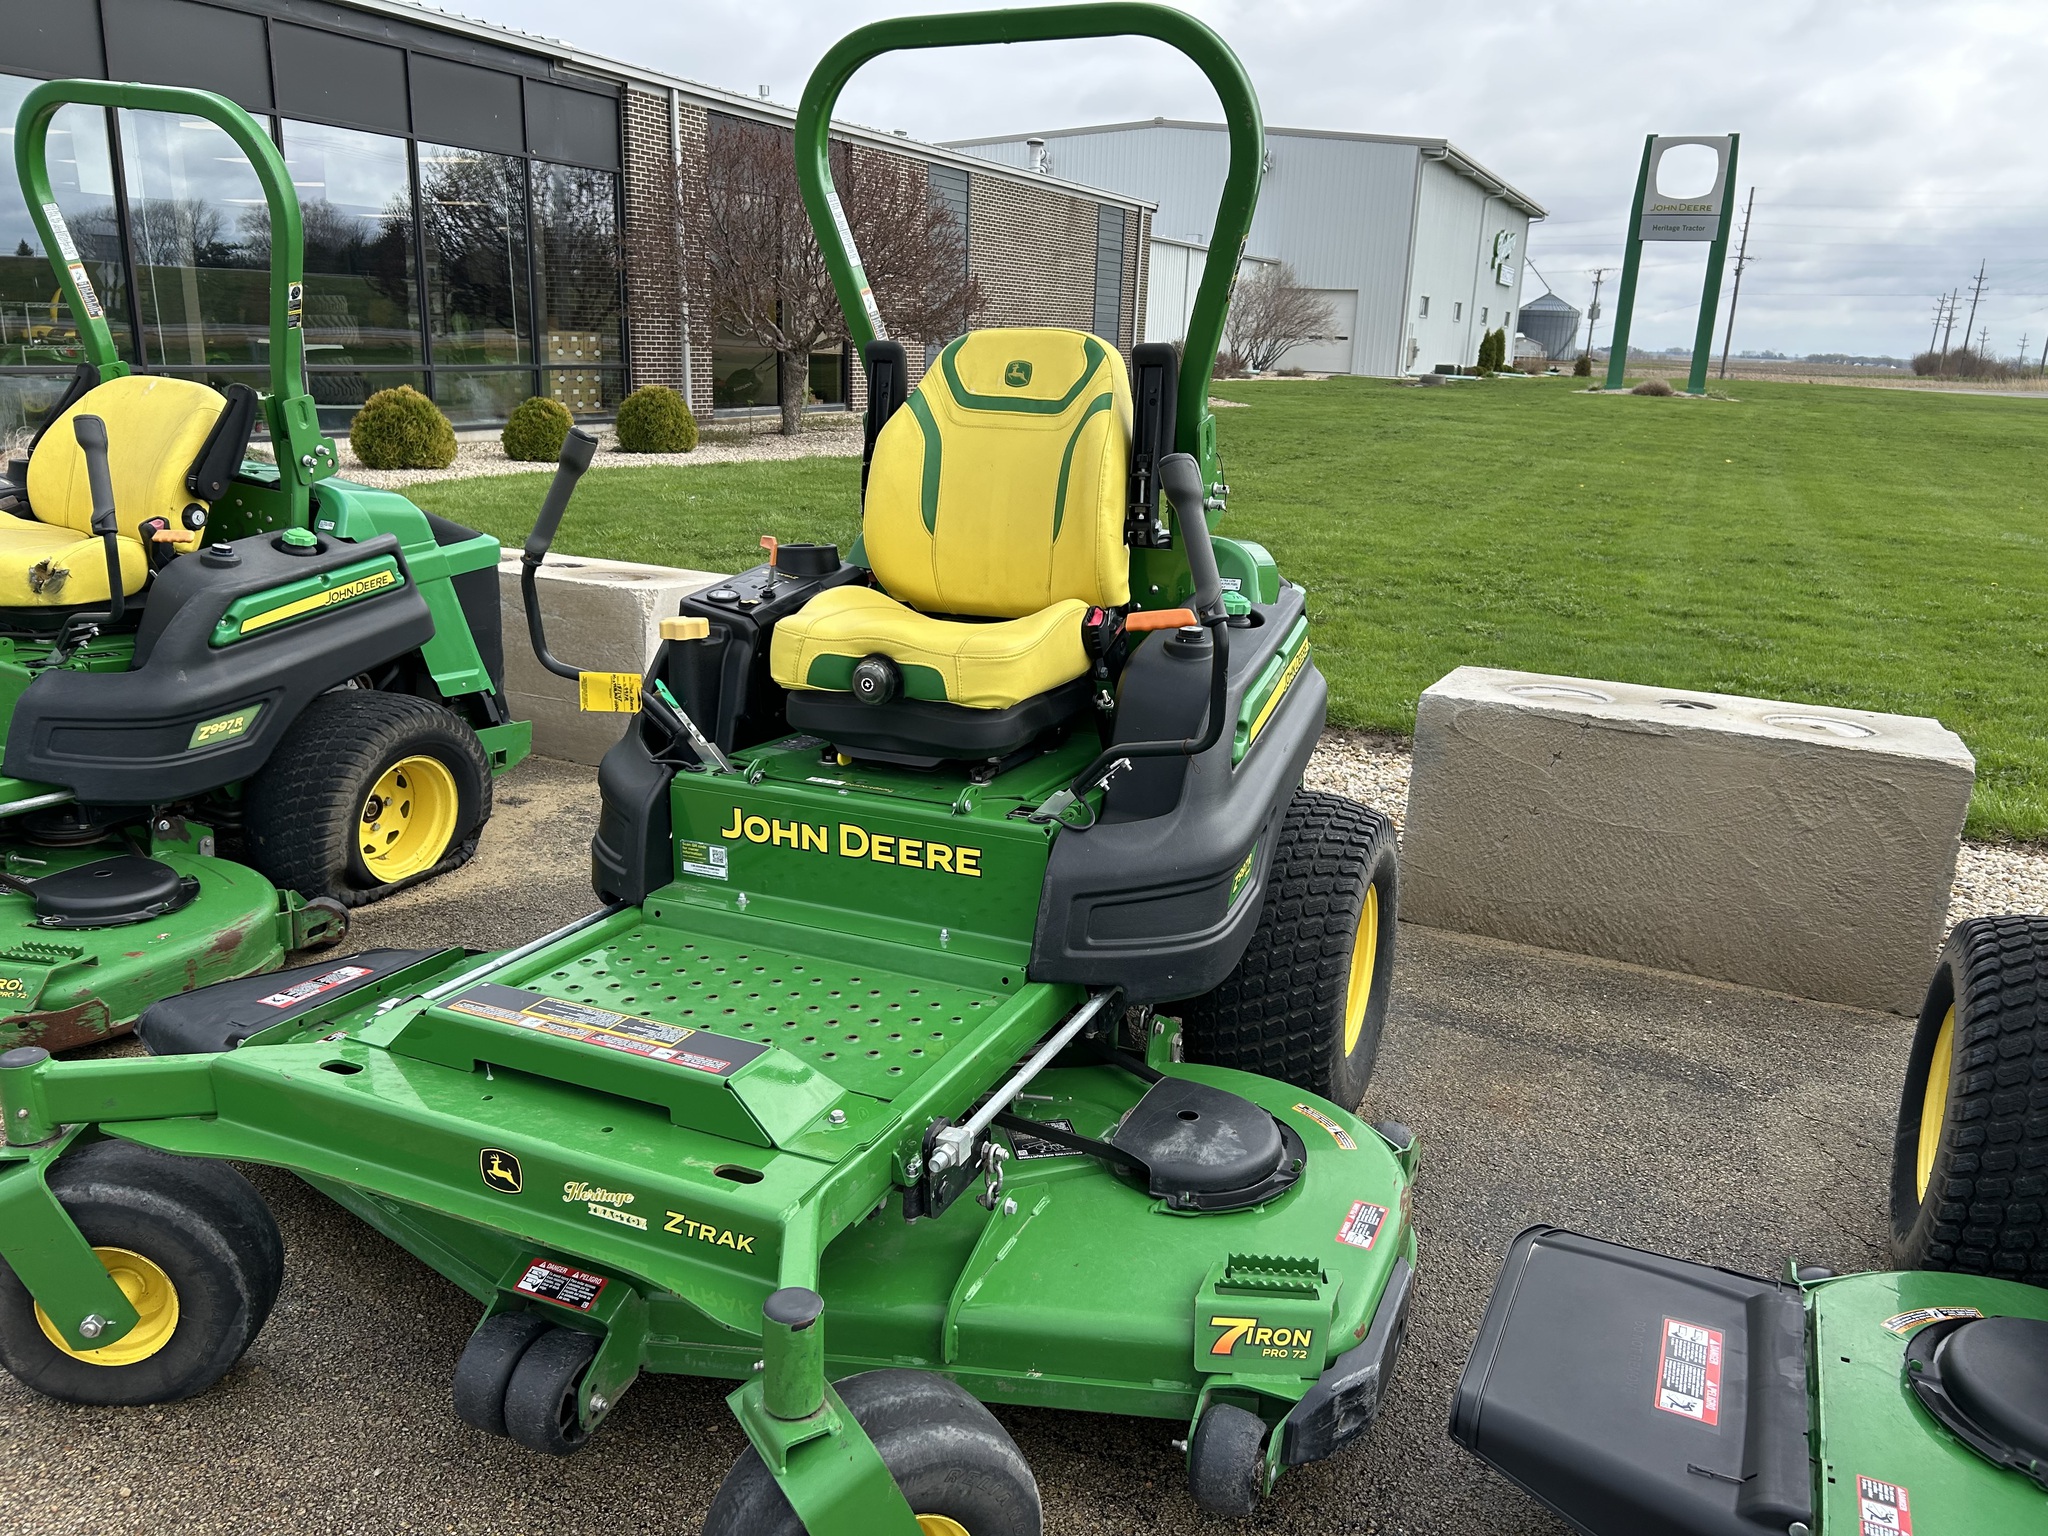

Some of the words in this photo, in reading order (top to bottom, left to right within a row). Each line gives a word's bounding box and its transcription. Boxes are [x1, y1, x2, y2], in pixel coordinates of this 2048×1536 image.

[1650, 204, 1677, 212] JOHN
[1679, 203, 1713, 212] DEERE
[1652, 224, 1680, 232] Heritage
[1682, 224, 1705, 232] Tractor
[325, 586, 354, 605] JOHN
[356, 574, 389, 593] DEERE
[198, 716, 244, 741] Z997R
[721, 807, 829, 854] JOHN
[838, 822, 983, 878] DEERE
[562, 1181, 635, 1207] Heritage
[588, 1202, 648, 1230] TRACTOR
[546, 1263, 568, 1274] DANGER
[580, 1273, 602, 1285] PELIGRO
[1262, 1348, 1289, 1359] PRO
[1292, 1349, 1308, 1360] 72
